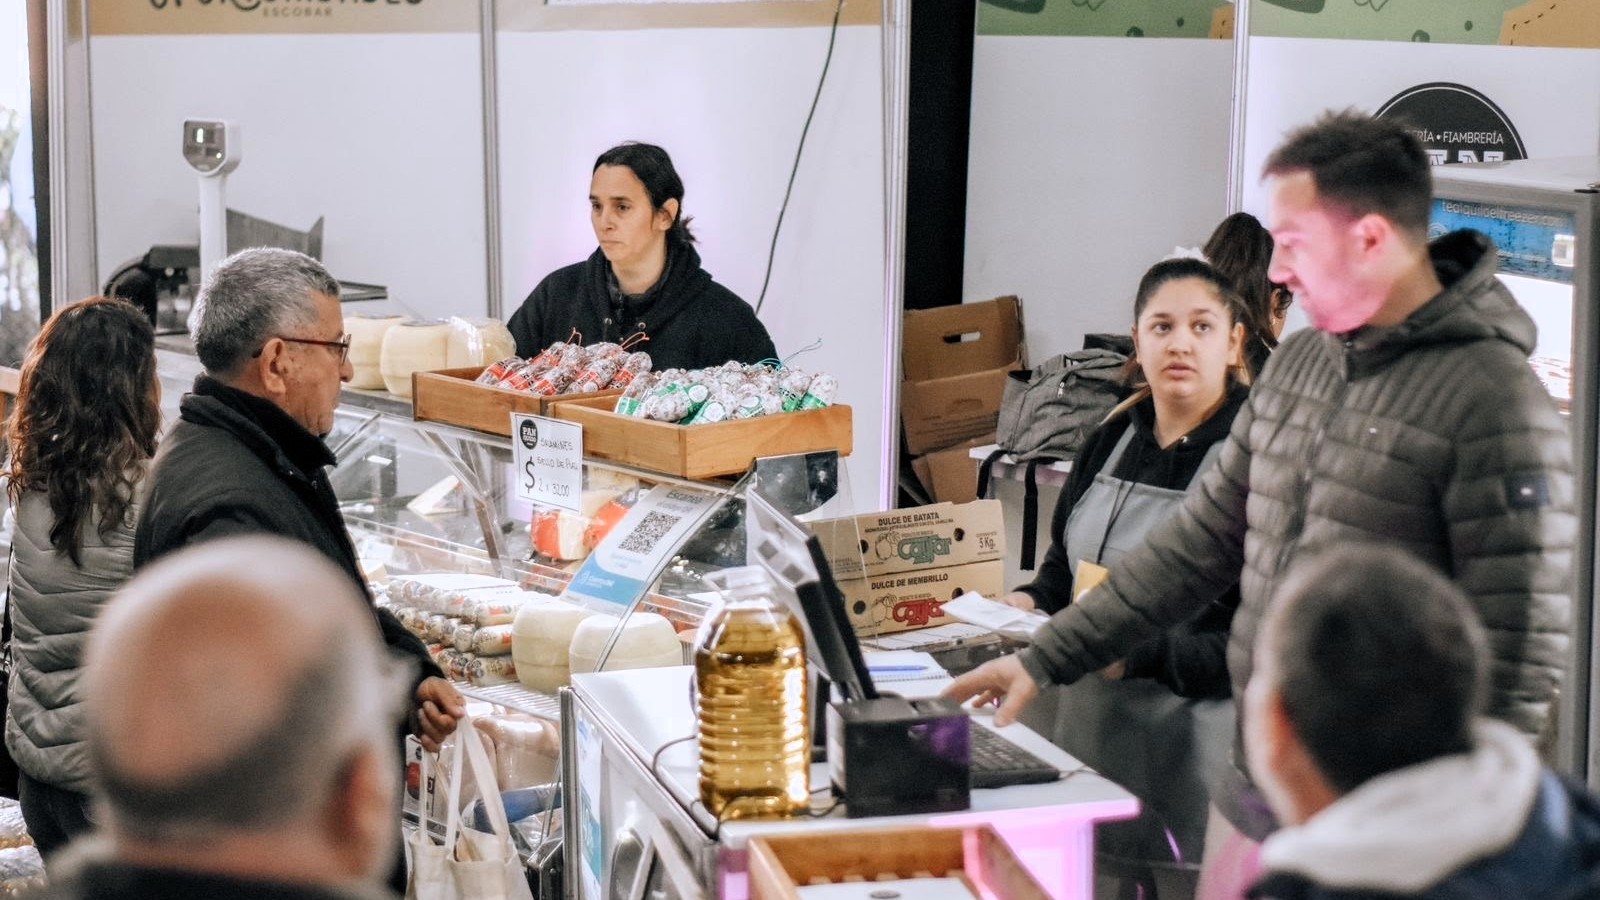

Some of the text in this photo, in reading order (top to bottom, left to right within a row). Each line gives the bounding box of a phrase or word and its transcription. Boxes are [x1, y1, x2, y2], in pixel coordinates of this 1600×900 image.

[263, 8, 333, 17] ESCOBAR
[1443, 130, 1504, 144] FIAMBRERÍA
[522, 427, 537, 437] PAN
[525, 456, 535, 493] $
[878, 516, 901, 526] DULCE
[903, 514, 912, 524] DE
[914, 512, 940, 522] BATATA
[979, 537, 984, 549] 5
[871, 573, 949, 590] DULCE DE MEMBRILLO
